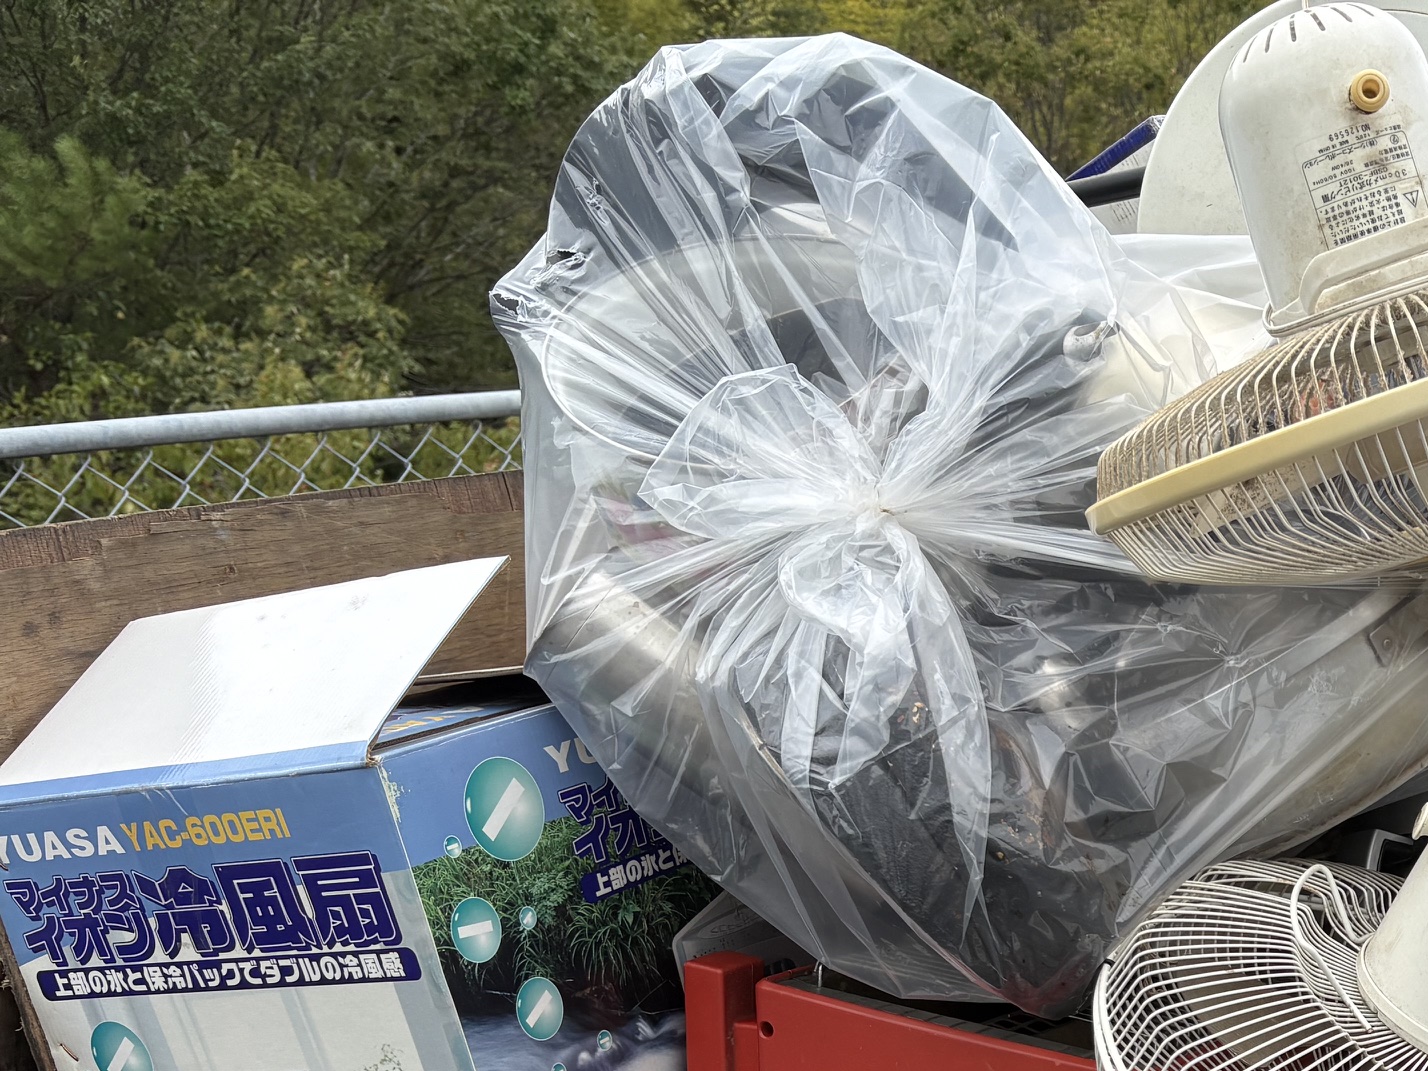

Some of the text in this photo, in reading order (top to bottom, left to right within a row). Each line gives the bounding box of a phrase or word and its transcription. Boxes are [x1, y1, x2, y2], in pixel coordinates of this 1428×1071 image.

[120, 807, 291, 853] YAC-600ERI
[4, 870, 143, 919] マイナス
[131, 849, 407, 955] 冷風扇
[23, 912, 152, 965] イオン
[54, 951, 406, 997] 上部の氷と保冷パックでダブルの冷風感
